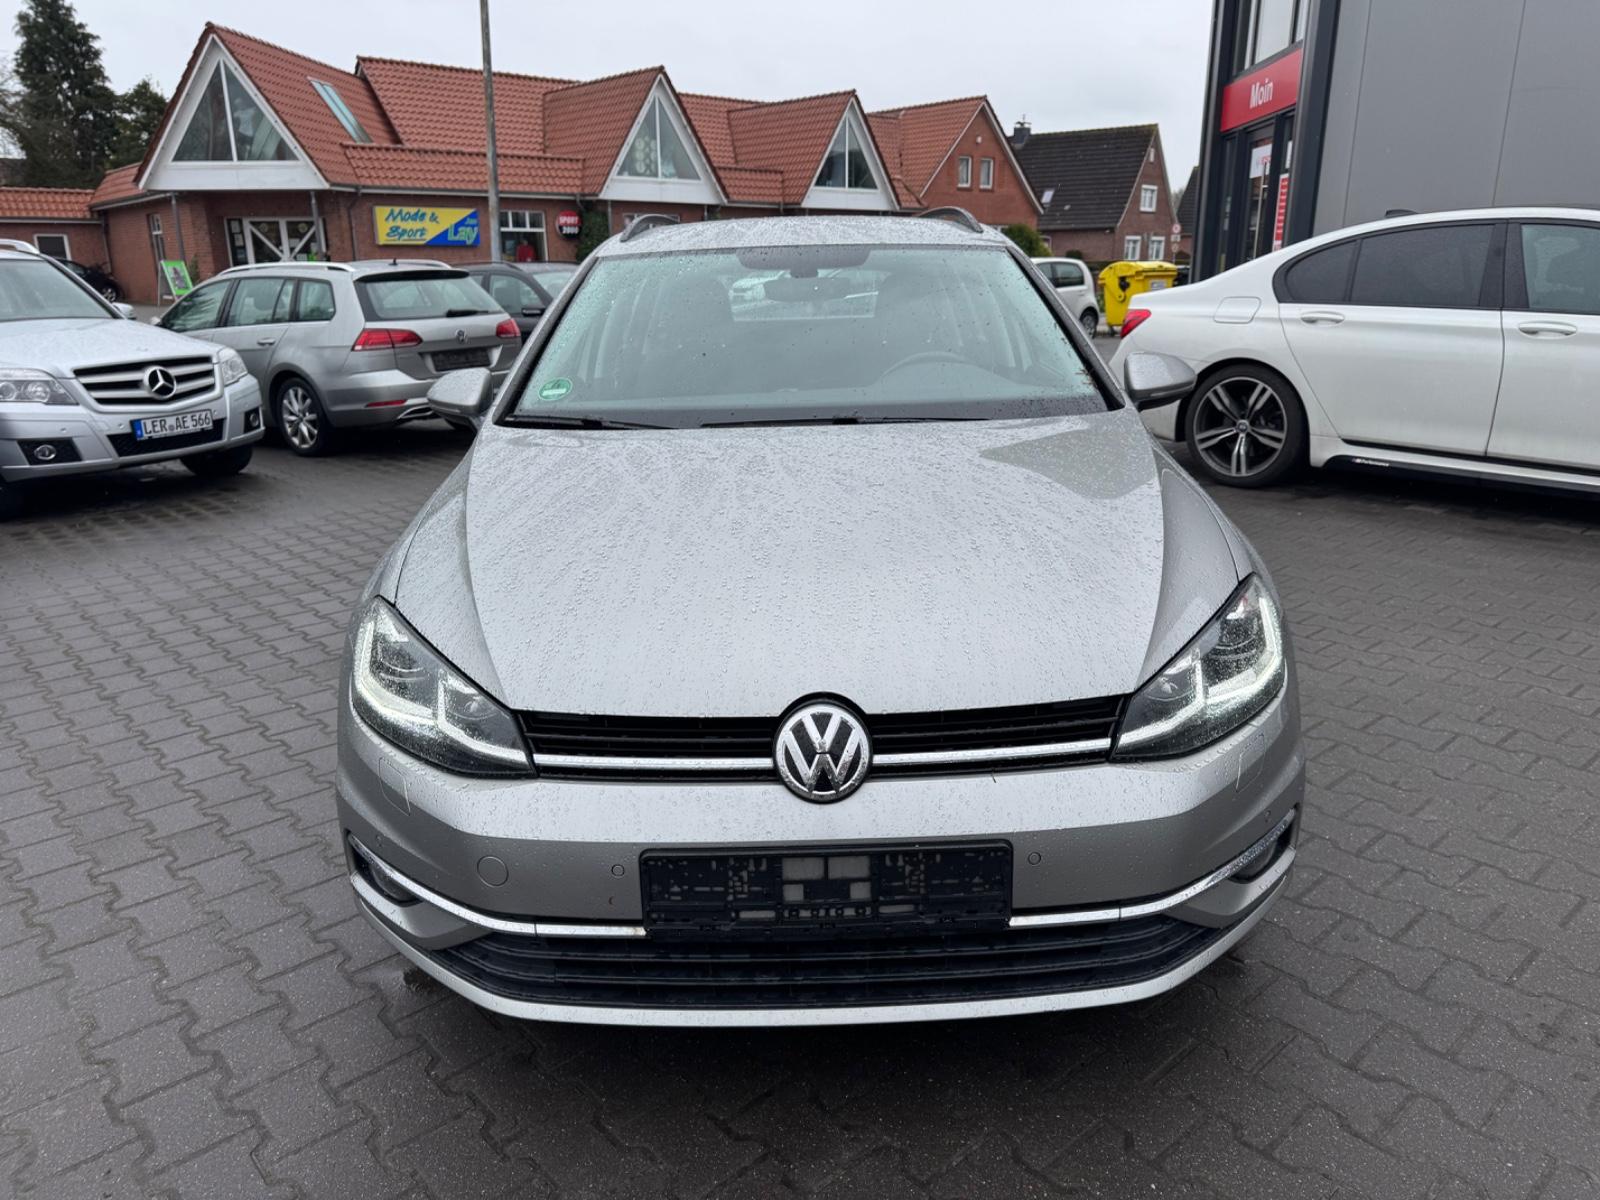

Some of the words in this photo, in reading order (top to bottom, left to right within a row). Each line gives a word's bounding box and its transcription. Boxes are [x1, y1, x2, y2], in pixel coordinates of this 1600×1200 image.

[1249, 77, 1274, 109] Moin
[385, 207, 427, 222] Mode
[429, 212, 440, 224] &
[559, 215, 579, 225] SPORT
[385, 225, 427, 240] Sport
[447, 223, 479, 245] Lay
[562, 225, 579, 234] 2000
[143, 418, 168, 435] LER
[175, 415, 190, 430] AE
[191, 412, 211, 428] 566
